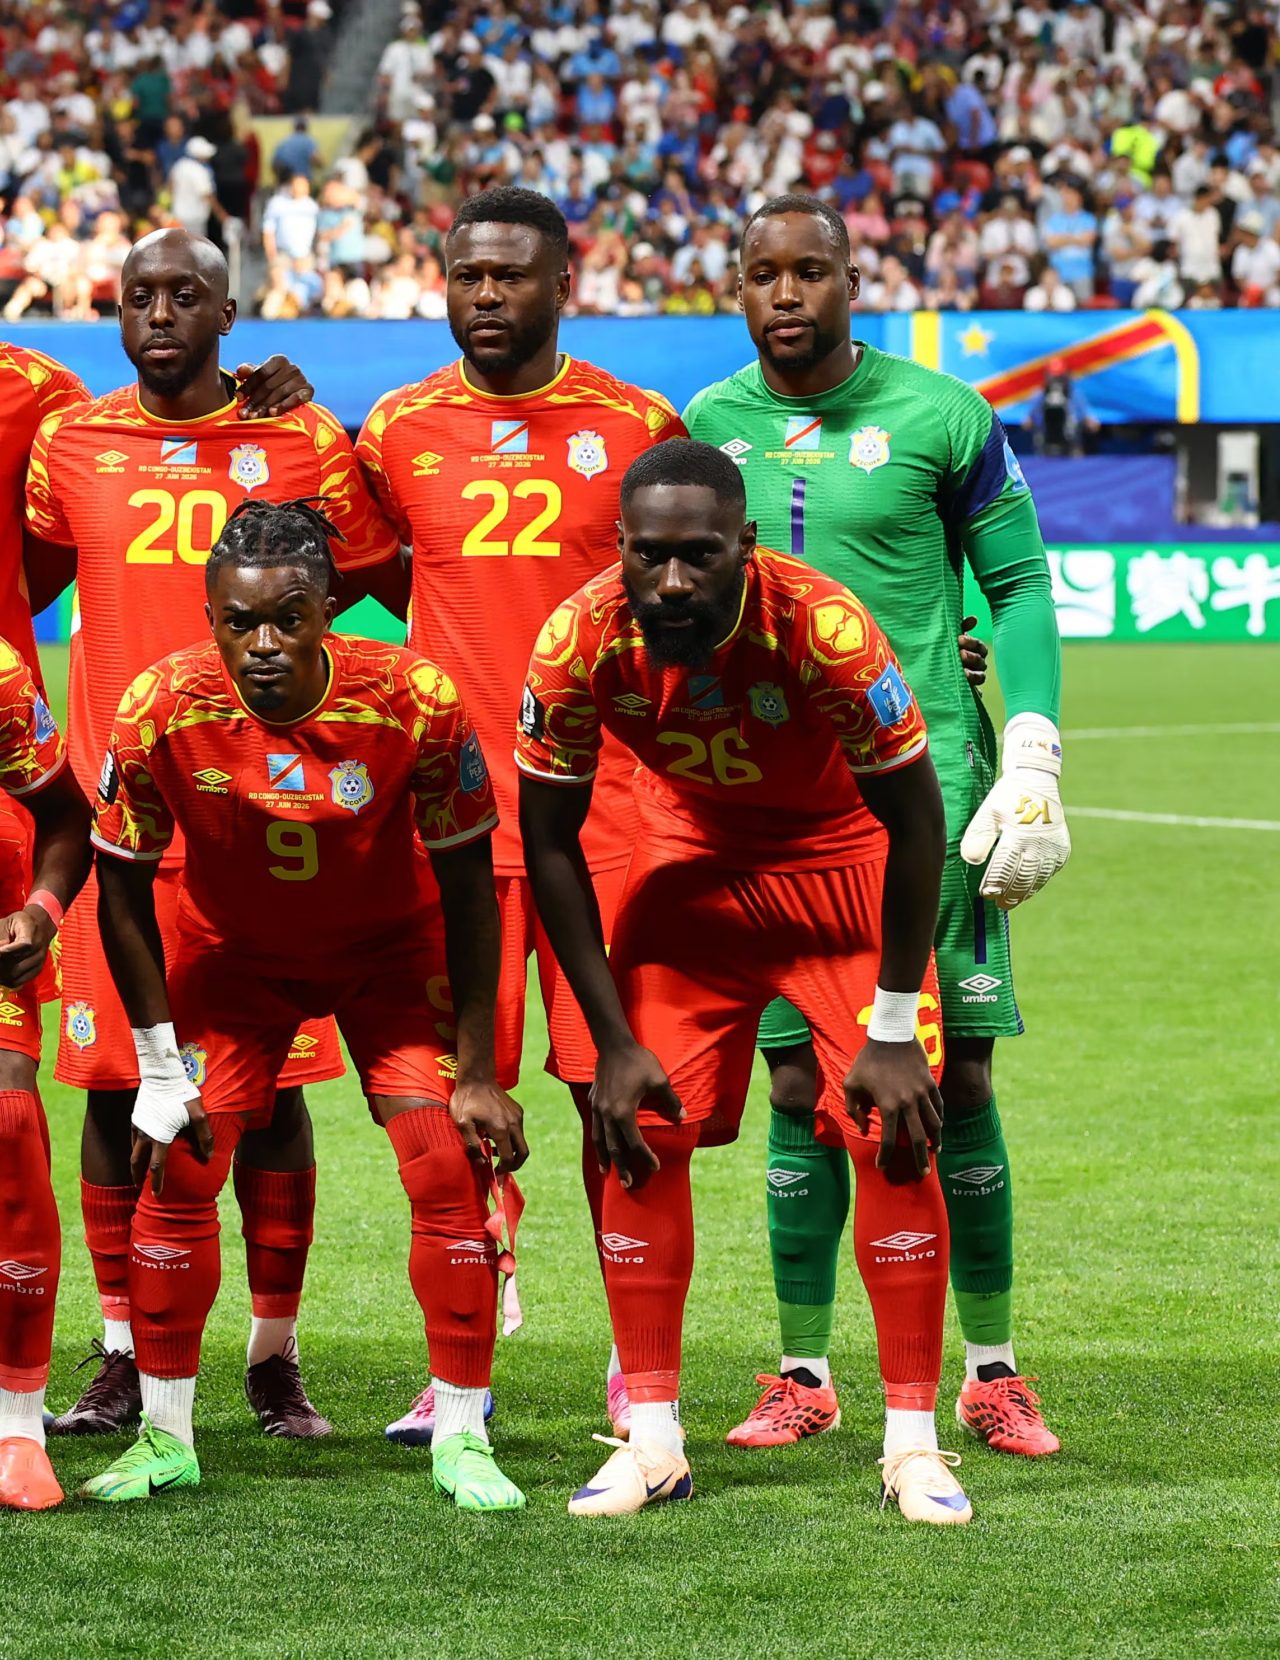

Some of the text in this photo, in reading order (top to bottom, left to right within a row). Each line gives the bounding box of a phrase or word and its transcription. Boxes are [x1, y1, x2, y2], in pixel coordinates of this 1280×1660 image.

[413, 468, 440, 476] umbro
[575, 464, 601, 472] FECOFA
[461, 479, 562, 557] 22
[791, 479, 806, 554] 1
[125, 488, 227, 566] 20
[1126, 549, 1280, 636] 蒙牛
[614, 707, 647, 717] umbro
[656, 726, 763, 786] 26
[196, 785, 228, 794] umbro
[340, 795, 367, 806] FECOFA
[266, 820, 319, 881] 9
[962, 994, 999, 1003] umbro
[856, 993, 943, 1067] 6
[288, 1050, 315, 1059] umbro
[952, 1181, 1004, 1196] umbro
[132, 1255, 190, 1270] umbro
[876, 1250, 936, 1263] umbro
